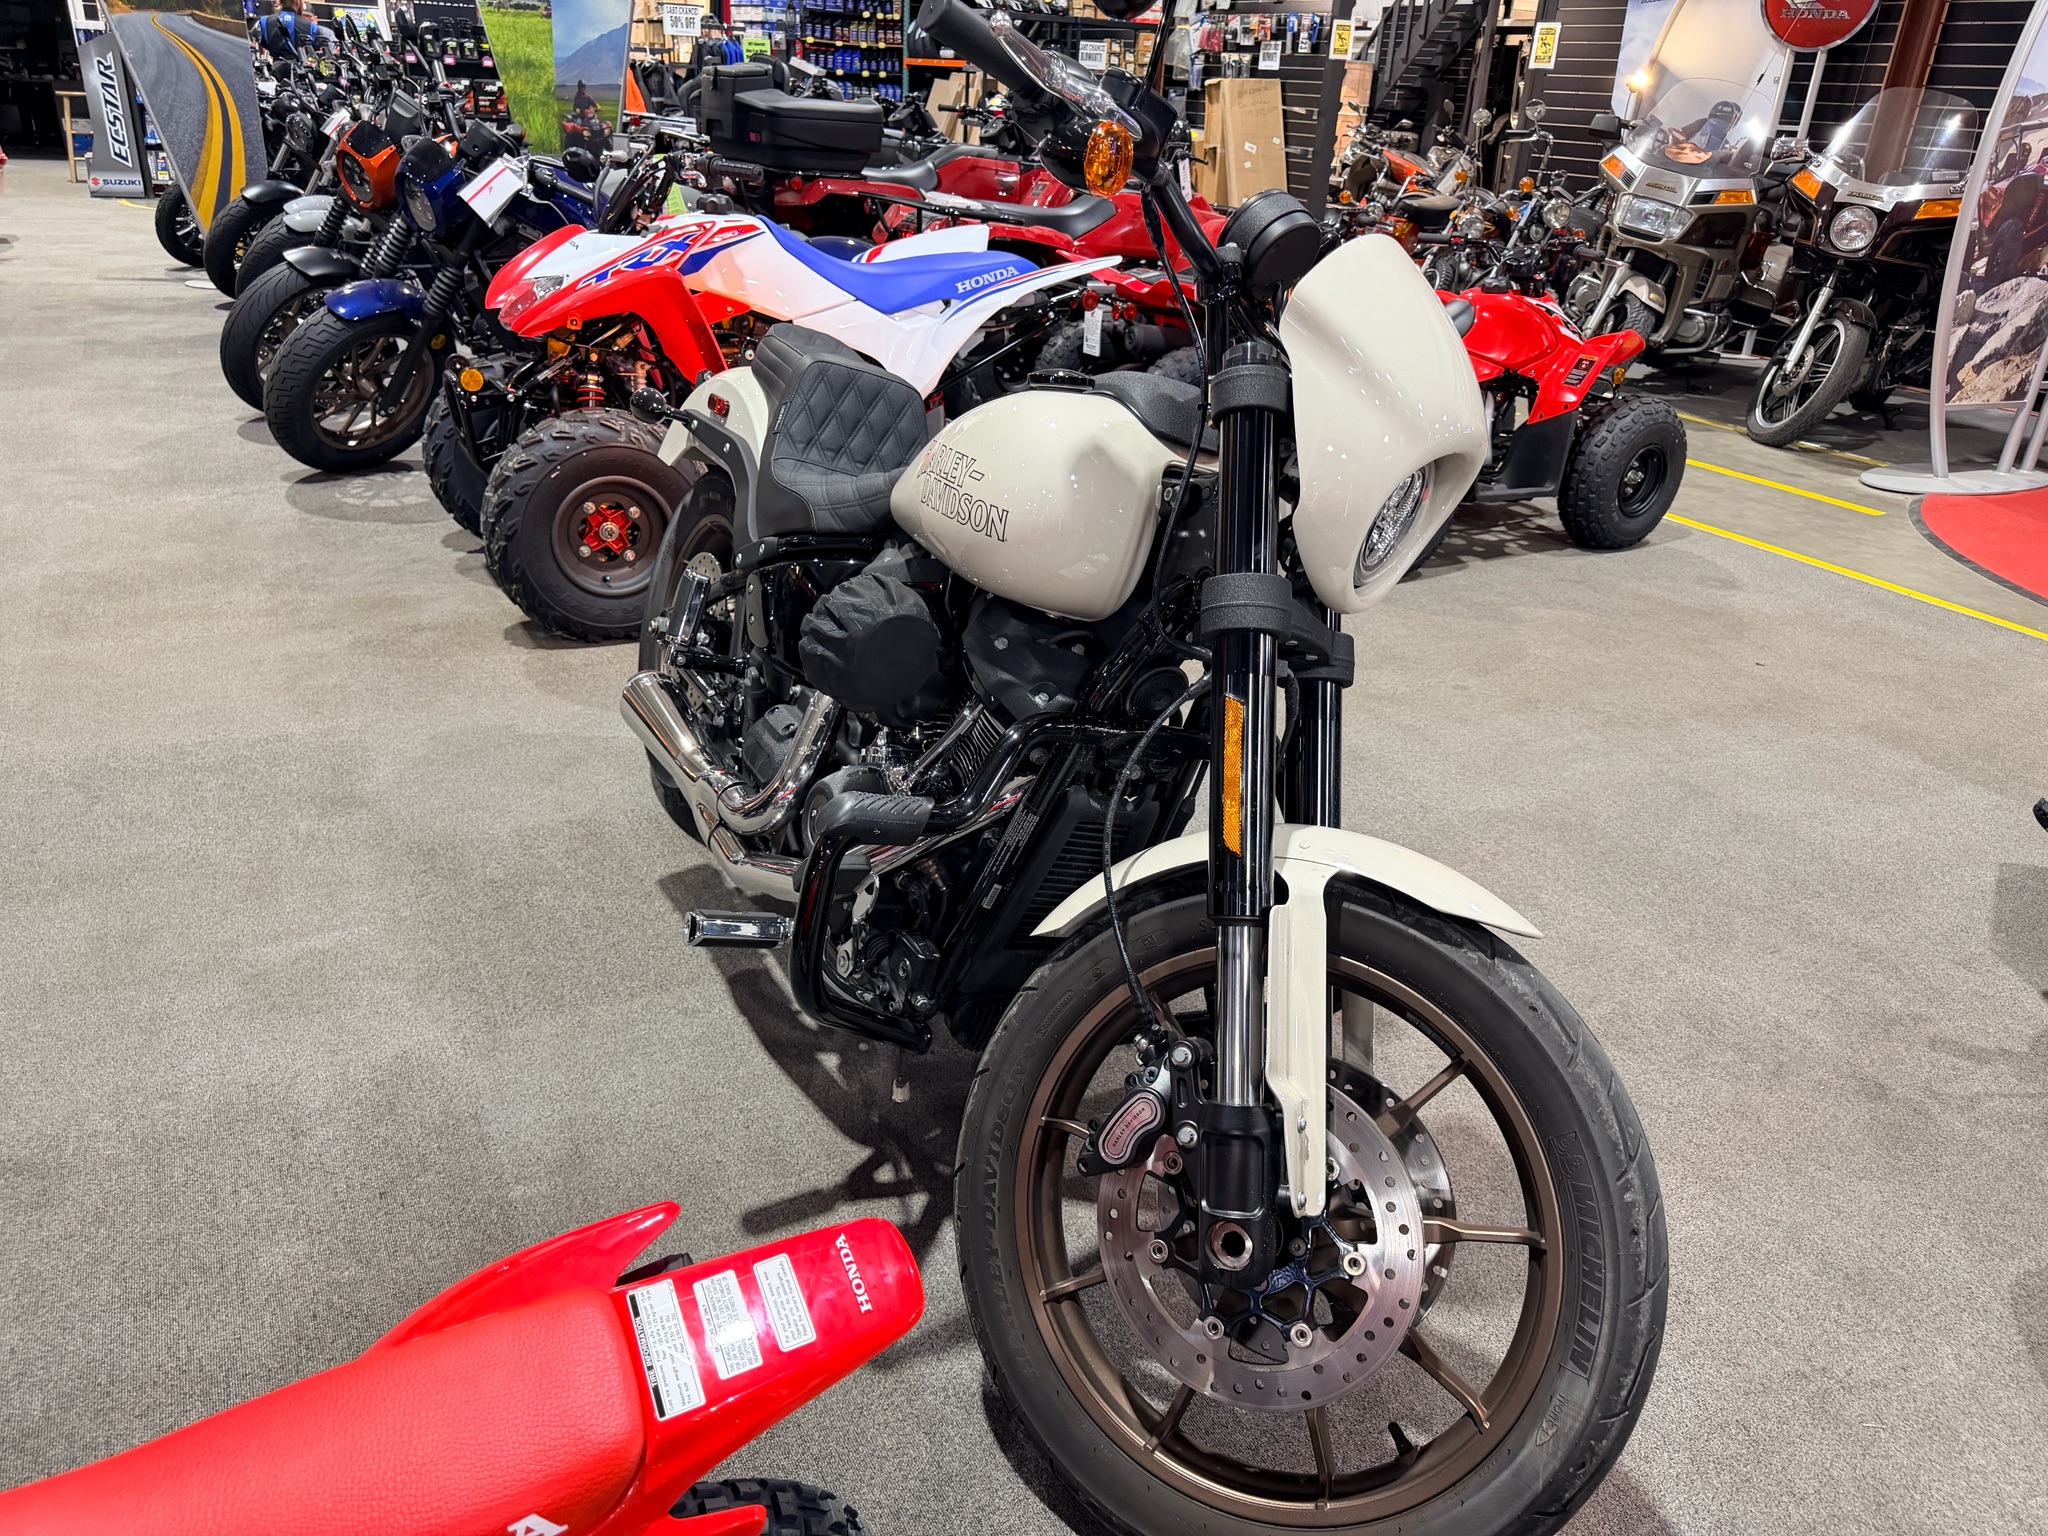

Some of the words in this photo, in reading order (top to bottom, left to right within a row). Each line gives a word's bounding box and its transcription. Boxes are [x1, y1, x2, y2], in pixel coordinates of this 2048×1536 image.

[666, 6, 680, 14] LAST
[670, 16, 684, 28] 50%
[685, 17, 696, 30] OFF
[1780, 8, 1850, 20] HONDA
[95, 51, 132, 168] ECSTAR
[102, 178, 141, 186] SUZUKI
[578, 232, 699, 287] TRX
[955, 266, 1020, 294] HONDA
[920, 472, 1009, 542] DAVIDSON
[1110, 1105, 1146, 1147] HARLEY-DAVIDSON
[836, 1233, 873, 1314] HONDA
[1569, 1181, 1603, 1378] MICHELIN
[634, 1316, 652, 1366] INFORMATION
[647, 1368, 658, 1387] TIRE
[672, 1365, 680, 1381] weight
[676, 1382, 686, 1406] Maximum
